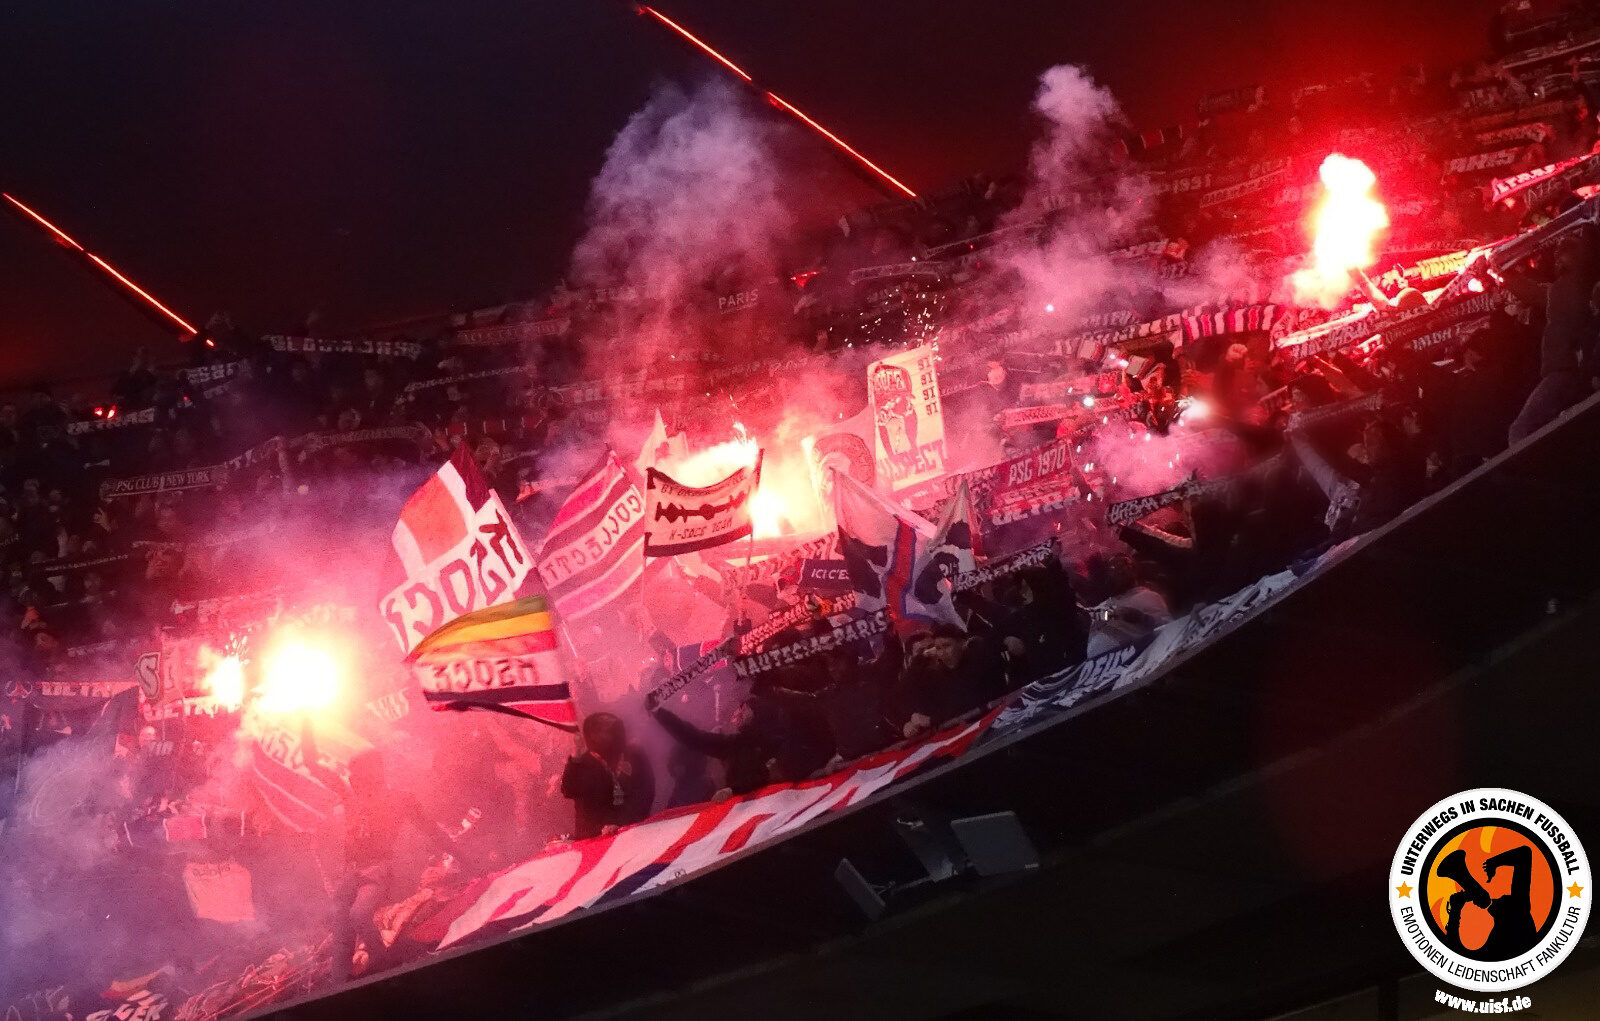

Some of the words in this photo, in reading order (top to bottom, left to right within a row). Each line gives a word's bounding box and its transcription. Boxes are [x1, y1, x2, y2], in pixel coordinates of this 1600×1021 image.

[717, 289, 758, 309] PARIS
[116, 479, 134, 492] PSG
[135, 477, 159, 490] CLUB
[166, 474, 185, 487] NEW
[186, 470, 210, 484] YORK
[1008, 457, 1032, 487] PSG
[1037, 444, 1066, 478] 1970
[833, 609, 889, 650] PARIS
